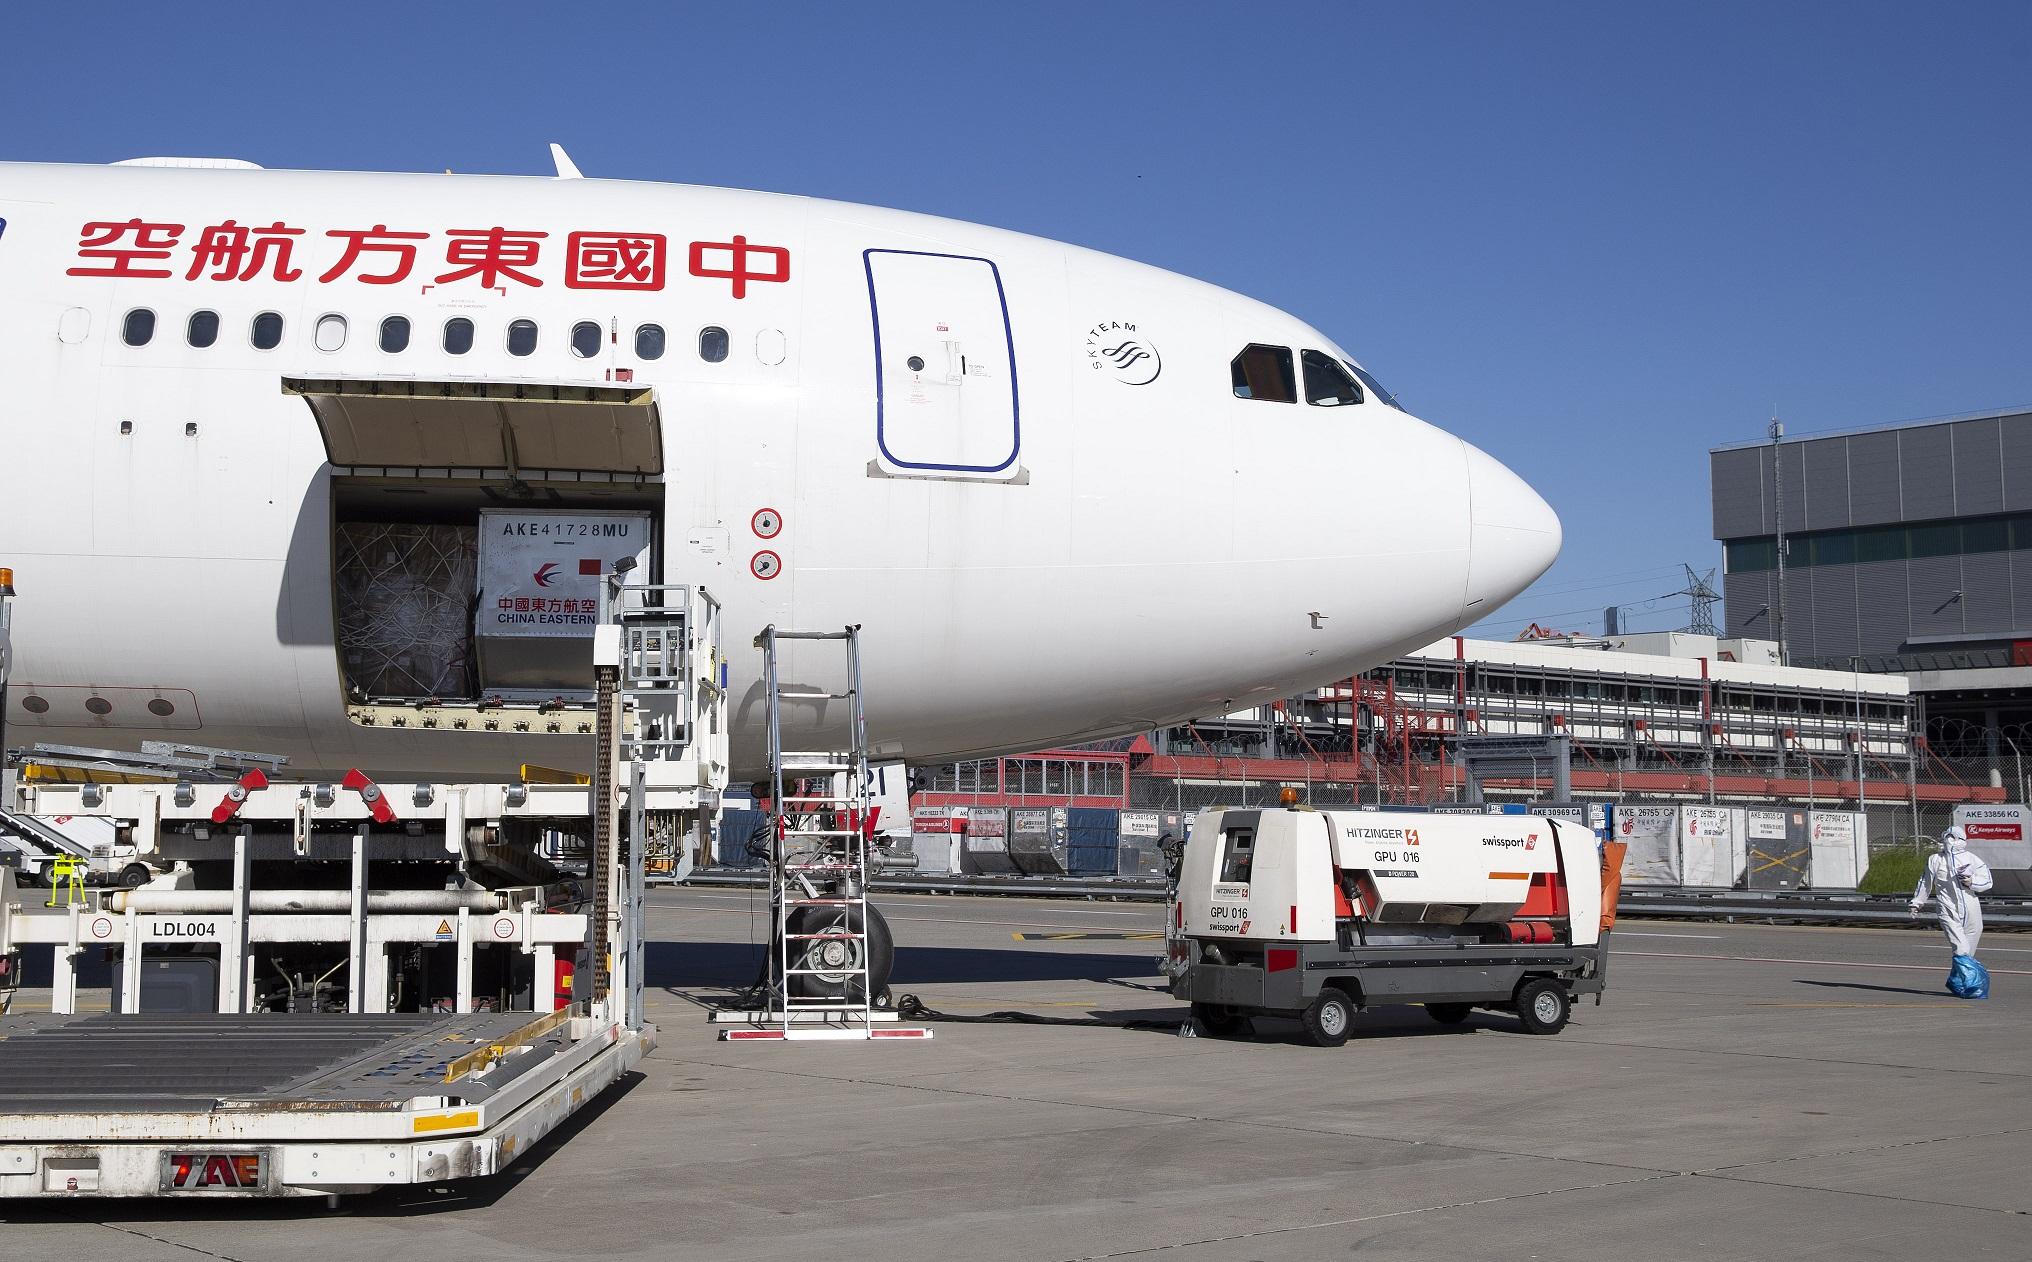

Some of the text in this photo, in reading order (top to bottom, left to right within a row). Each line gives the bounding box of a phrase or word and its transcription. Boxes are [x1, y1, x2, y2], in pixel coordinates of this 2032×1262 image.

[1086, 321, 1137, 370] SKYTEAM
[498, 597, 596, 613] 中國東方航空
[497, 613, 596, 625] CHINA EASTERN
[1533, 808, 1546, 816] AKE
[1571, 808, 1581, 816] CA
[1619, 808, 1634, 817] AKE
[1663, 808, 1675, 817] CA
[1686, 809, 1697, 818] AKE
[1718, 811, 1728, 819] CA
[1751, 811, 1761, 819] AKE
[1776, 812, 1784, 820] CA
[1966, 810, 2020, 818] AKE 33856 KQ
[1813, 813, 1824, 822] AKE
[1841, 814, 1850, 823] CA
[1346, 828, 1403, 839] HITZINGER
[1482, 835, 1524, 849] swissport
[1374, 851, 1420, 862] GPU 016
[1210, 906, 1248, 919] GPU 016
[153, 922, 216, 937] LDL004
[1209, 921, 1240, 934] swissport
